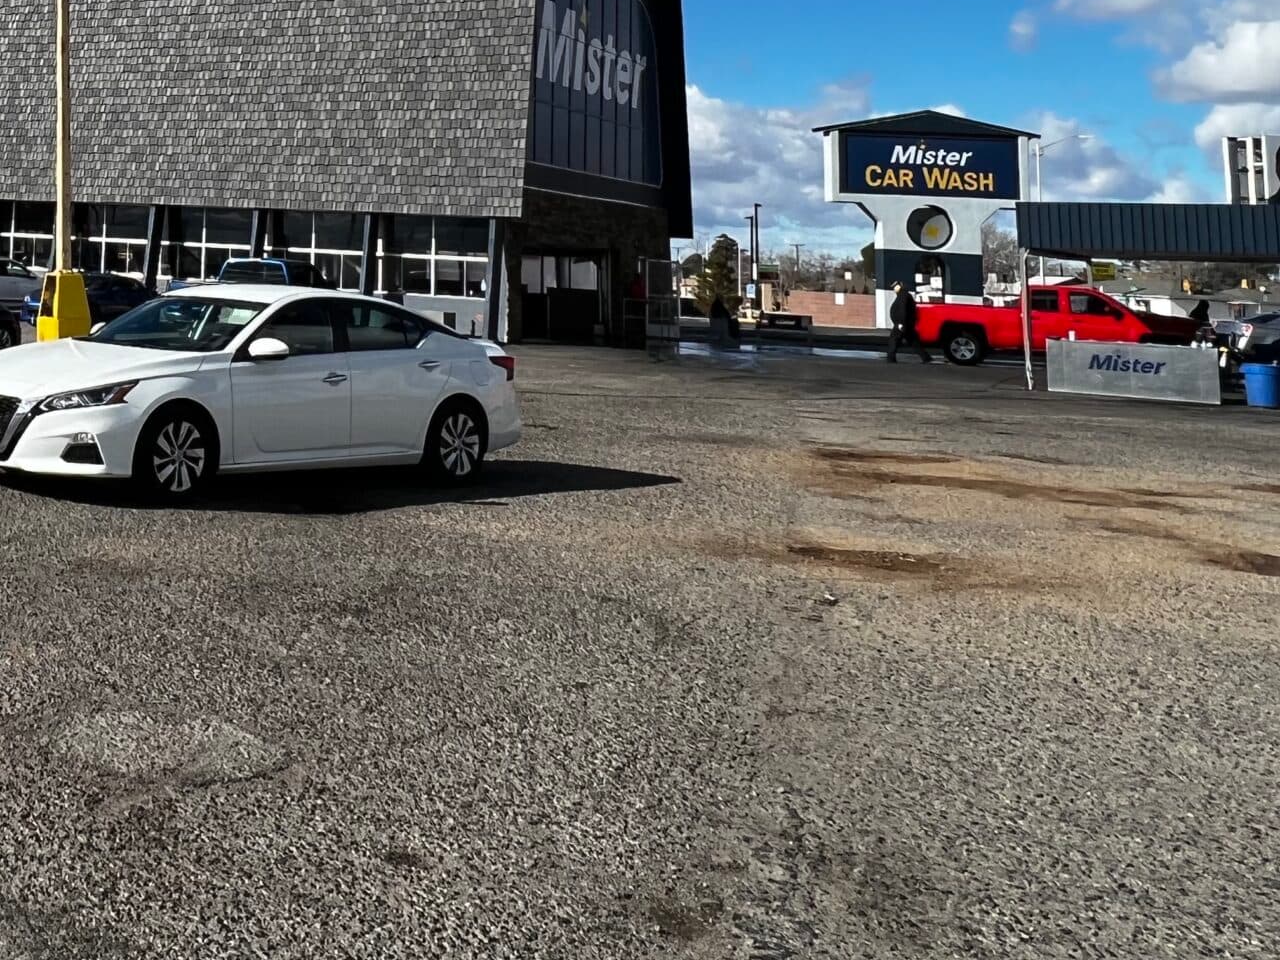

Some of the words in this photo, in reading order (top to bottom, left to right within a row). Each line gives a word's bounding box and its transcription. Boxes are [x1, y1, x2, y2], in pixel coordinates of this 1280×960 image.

[890, 141, 973, 167] Mister
[865, 164, 914, 188] CAR
[922, 166, 994, 192] WASH
[1088, 353, 1166, 375] Mister
